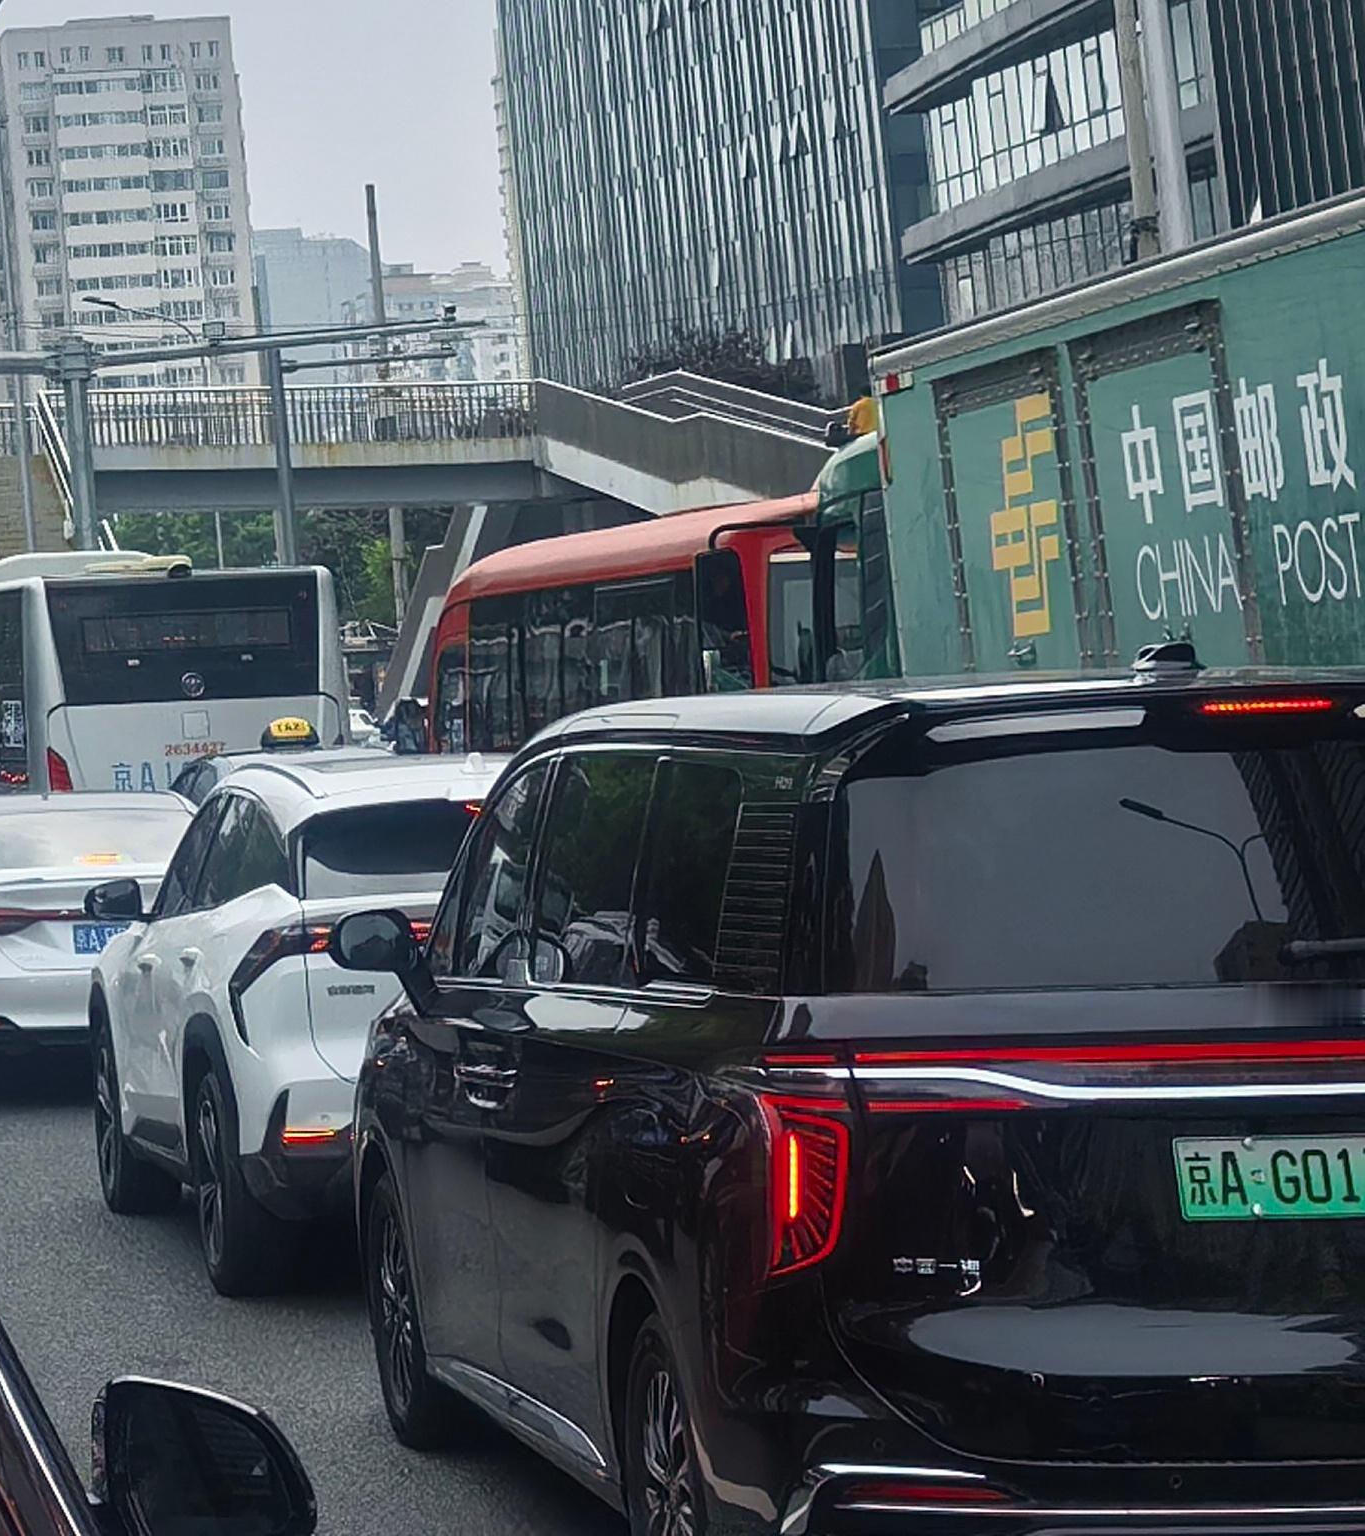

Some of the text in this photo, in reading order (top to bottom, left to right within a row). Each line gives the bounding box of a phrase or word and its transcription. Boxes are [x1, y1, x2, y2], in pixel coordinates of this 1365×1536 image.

[1120, 357, 1357, 525] 中国邮政
[1136, 513, 1361, 621] CHINA POST
